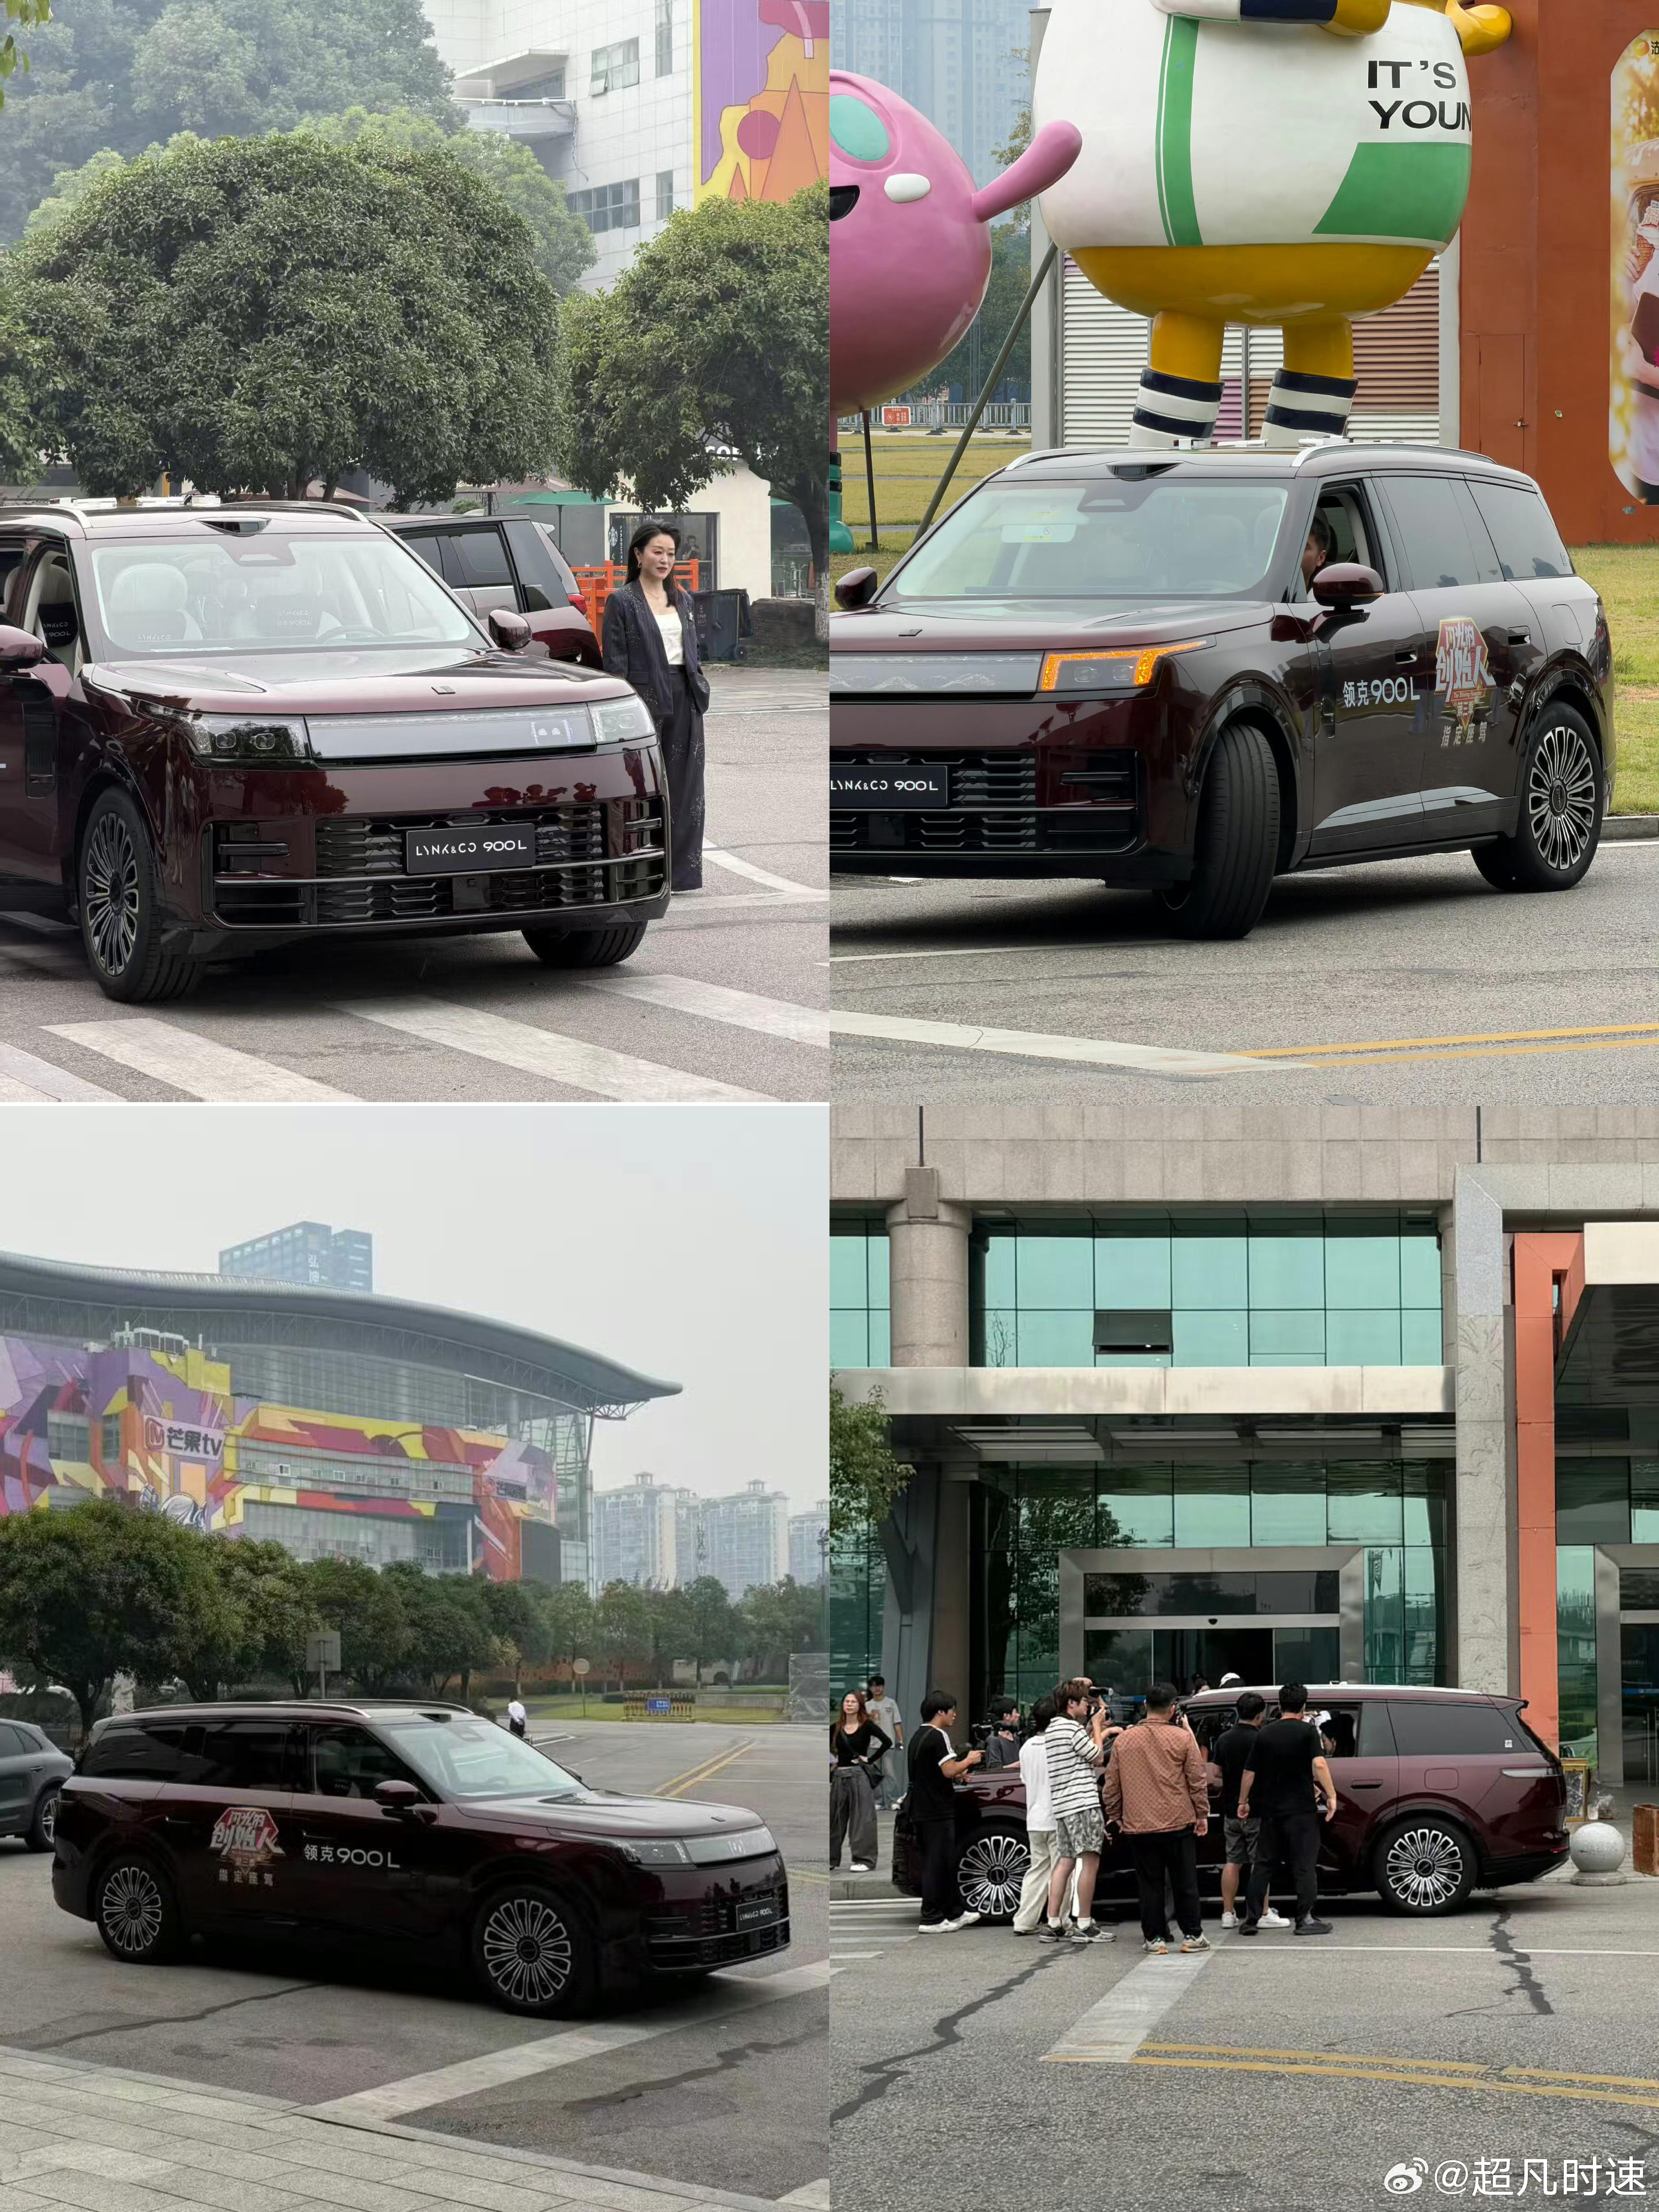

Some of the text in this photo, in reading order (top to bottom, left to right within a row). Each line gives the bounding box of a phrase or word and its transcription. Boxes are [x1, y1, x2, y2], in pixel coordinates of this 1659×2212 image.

[1435, 645, 1497, 702] 创始人
[1441, 721, 1487, 748] 指定座驾
[830, 780, 939, 791] LYNK&CO 900L
[416, 840, 527, 856] LYNK&CO 900L
[167, 1426, 222, 1456] 芒果tv
[210, 1822, 285, 1856] 创始人
